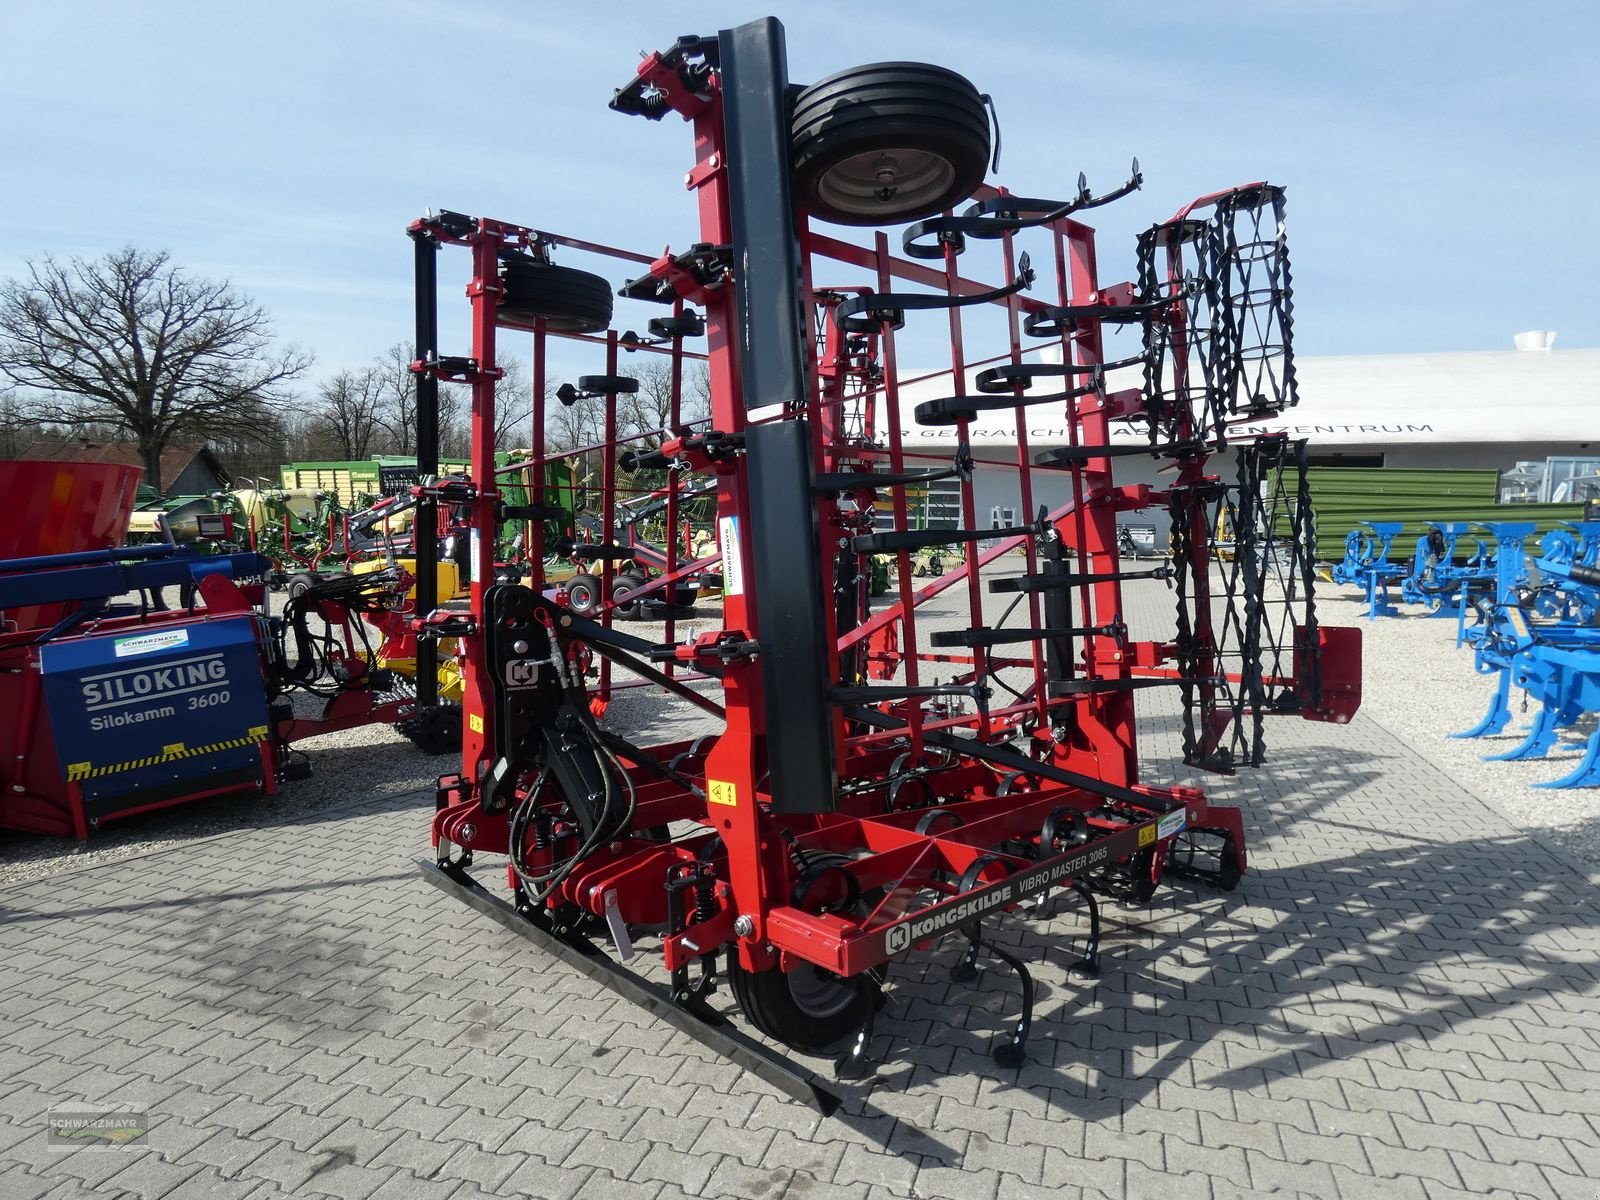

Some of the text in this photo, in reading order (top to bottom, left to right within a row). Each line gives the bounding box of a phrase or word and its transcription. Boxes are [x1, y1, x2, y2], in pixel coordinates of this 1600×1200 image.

[725, 528, 733, 587] SCHWARZMAYR
[122, 635, 178, 647] SCHWARZMAYR
[82, 660, 226, 704] SILOKING
[90, 691, 231, 731] Silokamm 3600
[912, 886, 1011, 939] KONGSKILDE
[1019, 871, 1050, 893] VIBRO
[1051, 855, 1087, 879] MASTER
[1088, 846, 1108, 867] 3065
